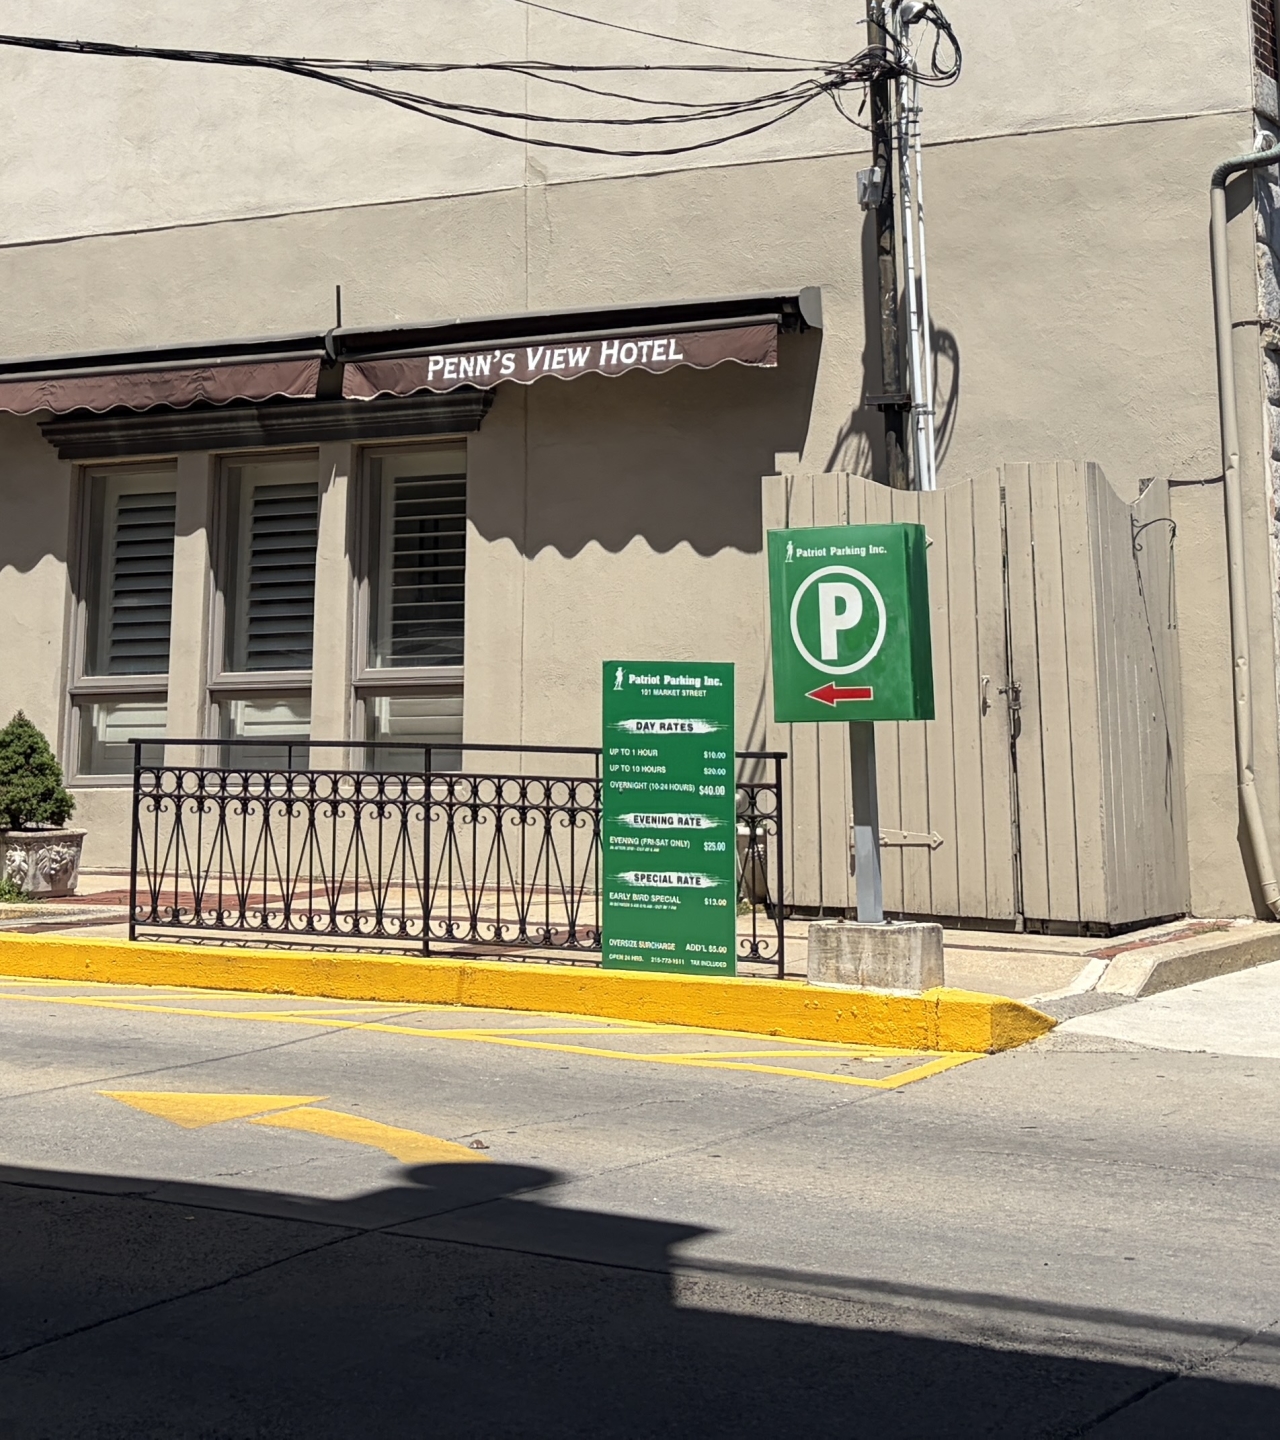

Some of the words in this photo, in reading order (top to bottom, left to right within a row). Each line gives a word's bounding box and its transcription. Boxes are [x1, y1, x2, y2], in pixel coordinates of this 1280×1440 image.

[796, 546, 827, 558] Patriot
[830, 545, 866, 557] Parking
[869, 544, 888, 555] Inc.
[818, 582, 863, 661] P
[628, 673, 660, 685] Patriot
[663, 674, 702, 688] Parking
[704, 675, 723, 686] Inc.
[653, 688, 680, 697] MARKET
[681, 689, 707, 697] STREET
[635, 721, 655, 731] DAY
[659, 722, 694, 732] RATES
[609, 748, 619, 756] UP
[621, 748, 631, 756] TO
[637, 748, 658, 757] HOUR
[703, 750, 726, 759] $10.00
[609, 764, 619, 772] UP
[621, 764, 631, 772] TO
[632, 765, 640, 773] 10
[641, 765, 666, 774] HOURS
[703, 767, 726, 776] $20.00
[609, 780, 647, 790] OVERNIGHT
[648, 782, 669, 791] (10-24
[669, 783, 695, 793] HOURS)
[698, 785, 726, 796] $40.00
[633, 814, 674, 825] EVENING
[677, 816, 702, 827] RATE
[609, 835, 639, 845] EVENING
[640, 837, 669, 846] (FRI-SAT
[669, 839, 691, 849] ONLY)
[703, 841, 726, 852] $25.00
[633, 873, 673, 884] SPECIAL
[677, 874, 702, 885] RATE
[609, 891, 631, 900] EARLY
[632, 893, 649, 901] BIRD
[650, 894, 681, 904] SPECIAL
[704, 897, 727, 907] $13.00
[608, 938, 638, 948] OVERSIZE
[638, 940, 676, 951] SURCHARGE
[685, 943, 707, 953] ADD'L
[608, 953, 624, 961] OPEN
